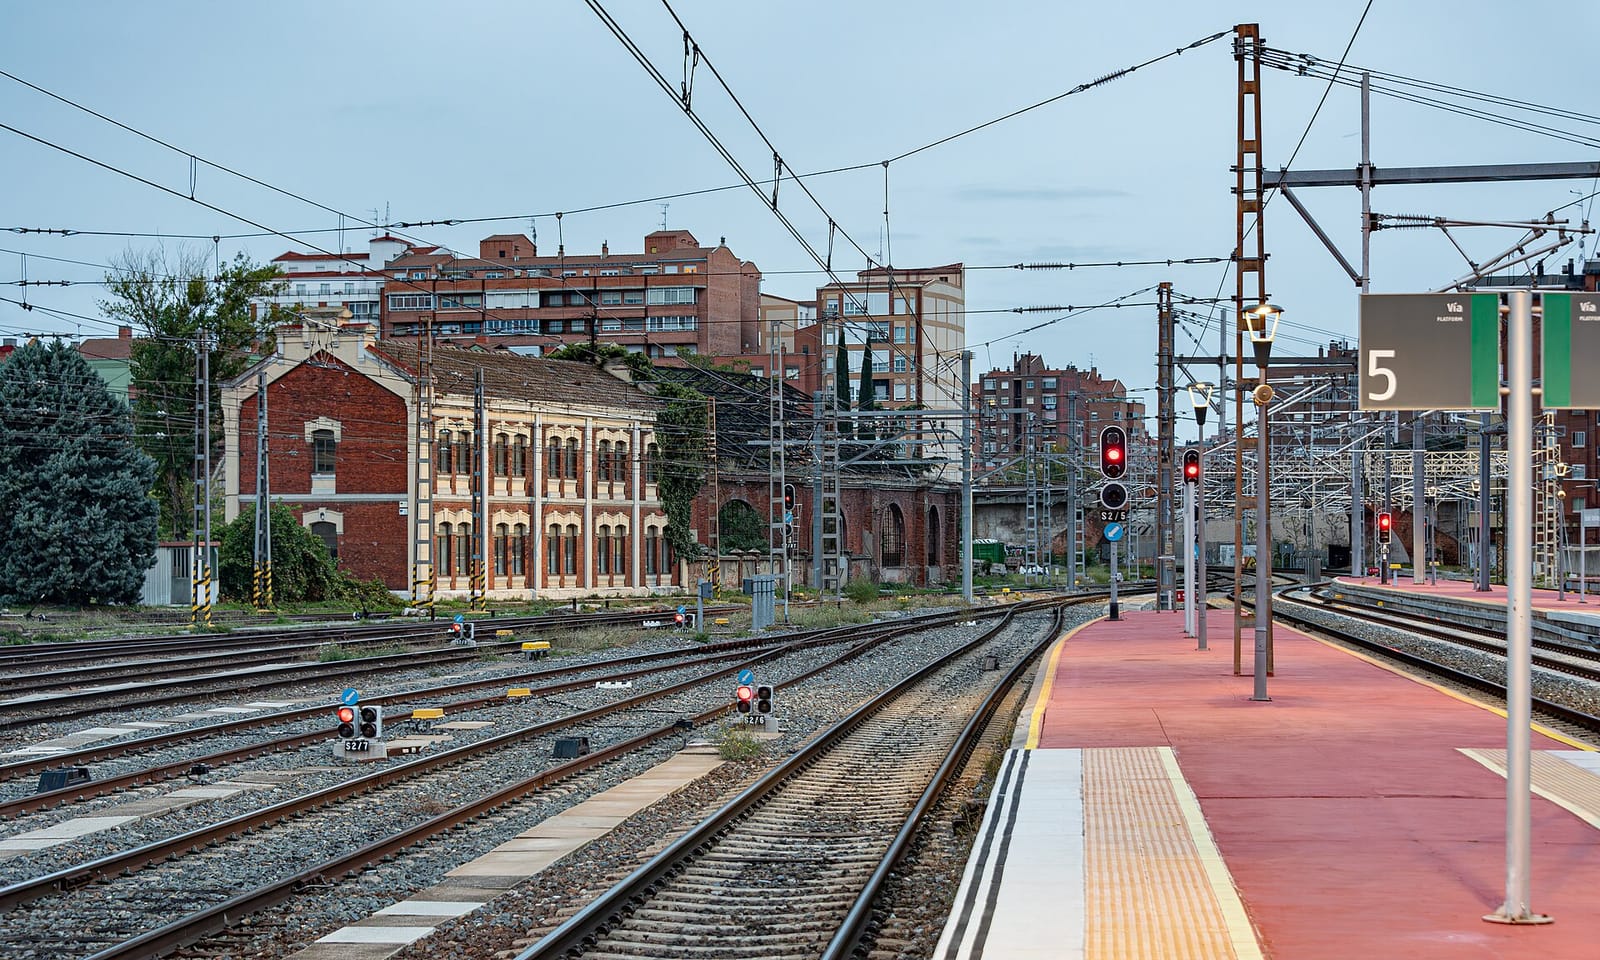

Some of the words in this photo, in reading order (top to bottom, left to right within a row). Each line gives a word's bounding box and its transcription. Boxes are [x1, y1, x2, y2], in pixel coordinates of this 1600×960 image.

[1447, 302, 1463, 312] Vía
[1580, 301, 1597, 312] Vía
[1368, 349, 1398, 402] 5
[1101, 511, 1126, 520] S2/5
[744, 716, 764, 724] S2/6
[345, 742, 368, 750] S2/7
